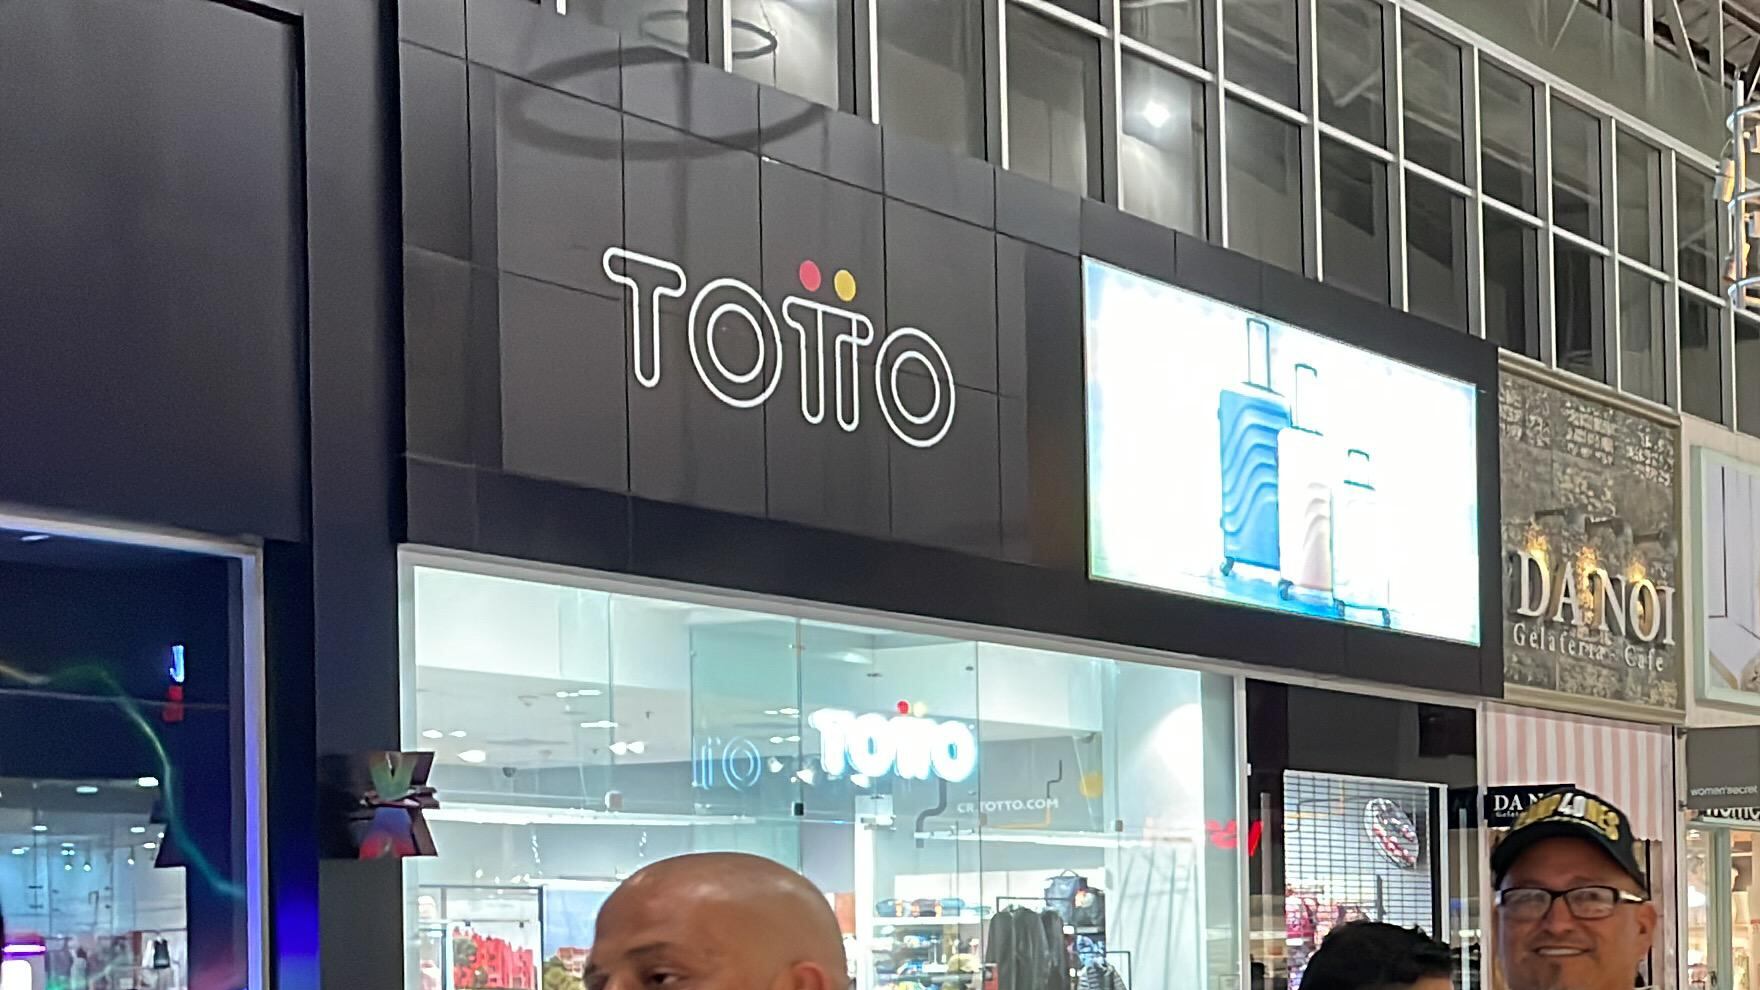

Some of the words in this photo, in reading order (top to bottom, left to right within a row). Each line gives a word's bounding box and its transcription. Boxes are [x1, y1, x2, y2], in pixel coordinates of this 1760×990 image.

[602, 246, 956, 448] TOTTO
[808, 706, 979, 783] TOTTO
[1494, 794, 1524, 812] DA
